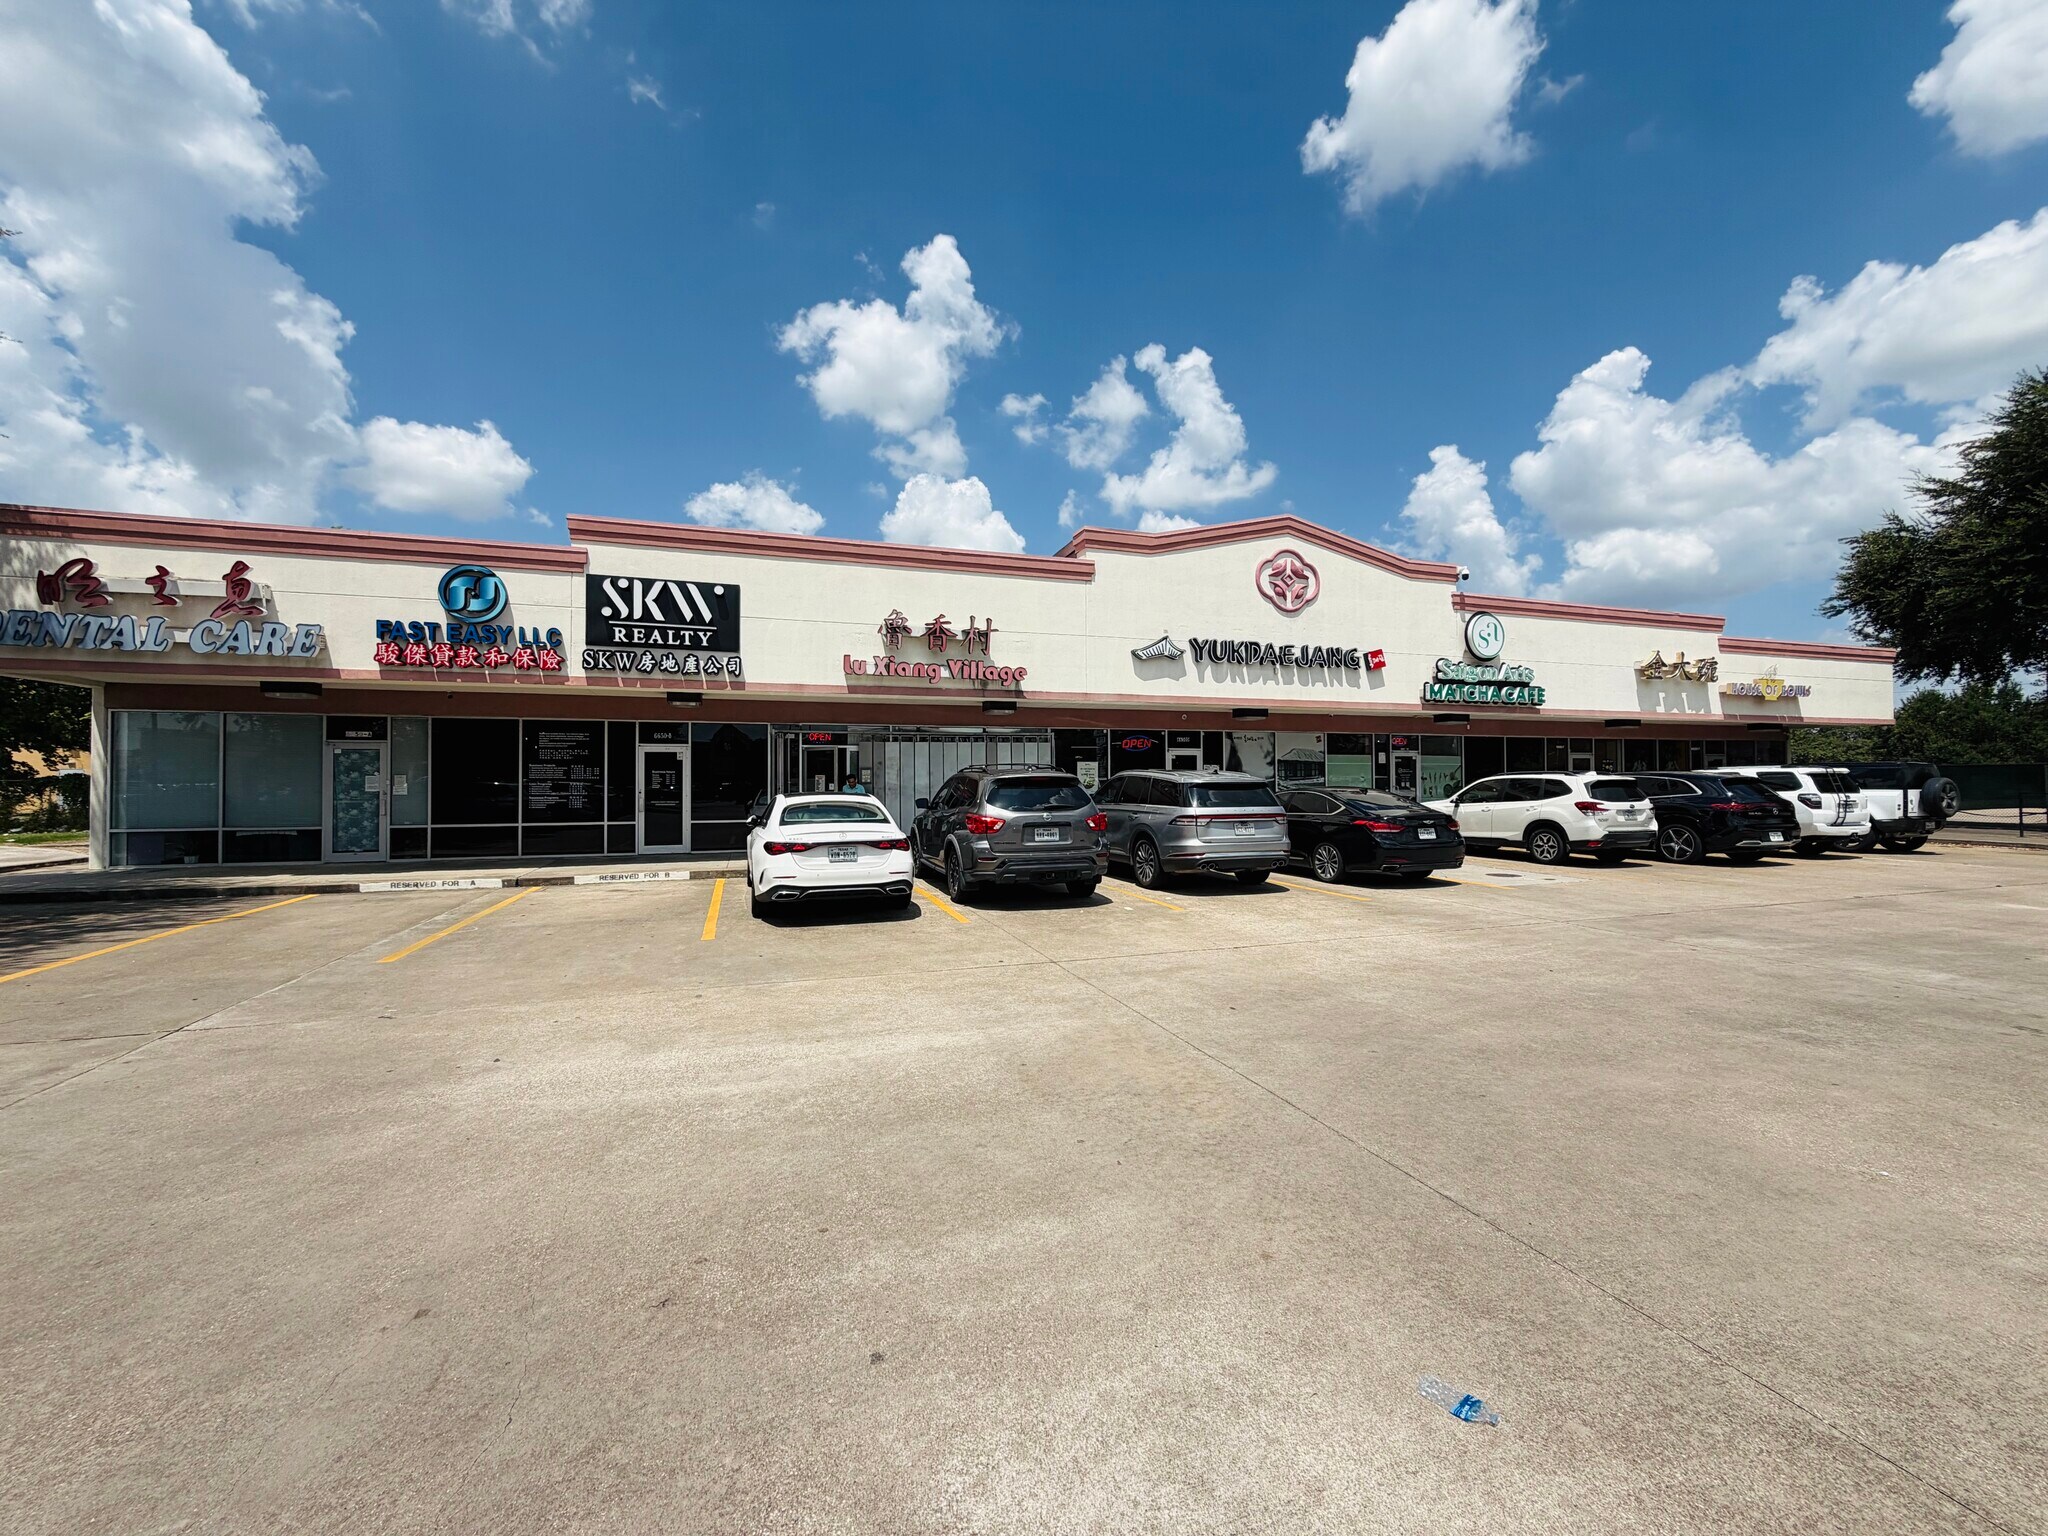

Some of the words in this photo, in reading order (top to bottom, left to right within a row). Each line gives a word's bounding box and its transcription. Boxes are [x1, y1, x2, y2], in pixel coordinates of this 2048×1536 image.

[601, 577, 724, 624] SKW
[0, 609, 171, 653] ENTAL
[190, 618, 323, 658] CARE
[376, 619, 441, 642] FAST
[446, 622, 513, 646] EASY
[519, 627, 562, 648] LLC
[613, 626, 713, 647] REALTY
[374, 642, 565, 672] 駿傑貸款和保險
[1188, 637, 1362, 670] YUKDAEJANG
[873, 655, 943, 684] Xiang
[947, 658, 1028, 687] Village
[1437, 658, 1499, 682] Saigon
[1500, 663, 1536, 683] Arts
[1425, 683, 1502, 703] MATCHA
[1502, 686, 1546, 705] CAFE
[1731, 683, 1762, 696] HOUSE
[1765, 684, 1778, 695] OF
[1781, 685, 1812, 697] BOWLS
[808, 732, 832, 741] OPEN
[1122, 739, 1152, 749] OPEN
[390, 881, 437, 889] RESERVED
[599, 873, 639, 881] RESERVED
